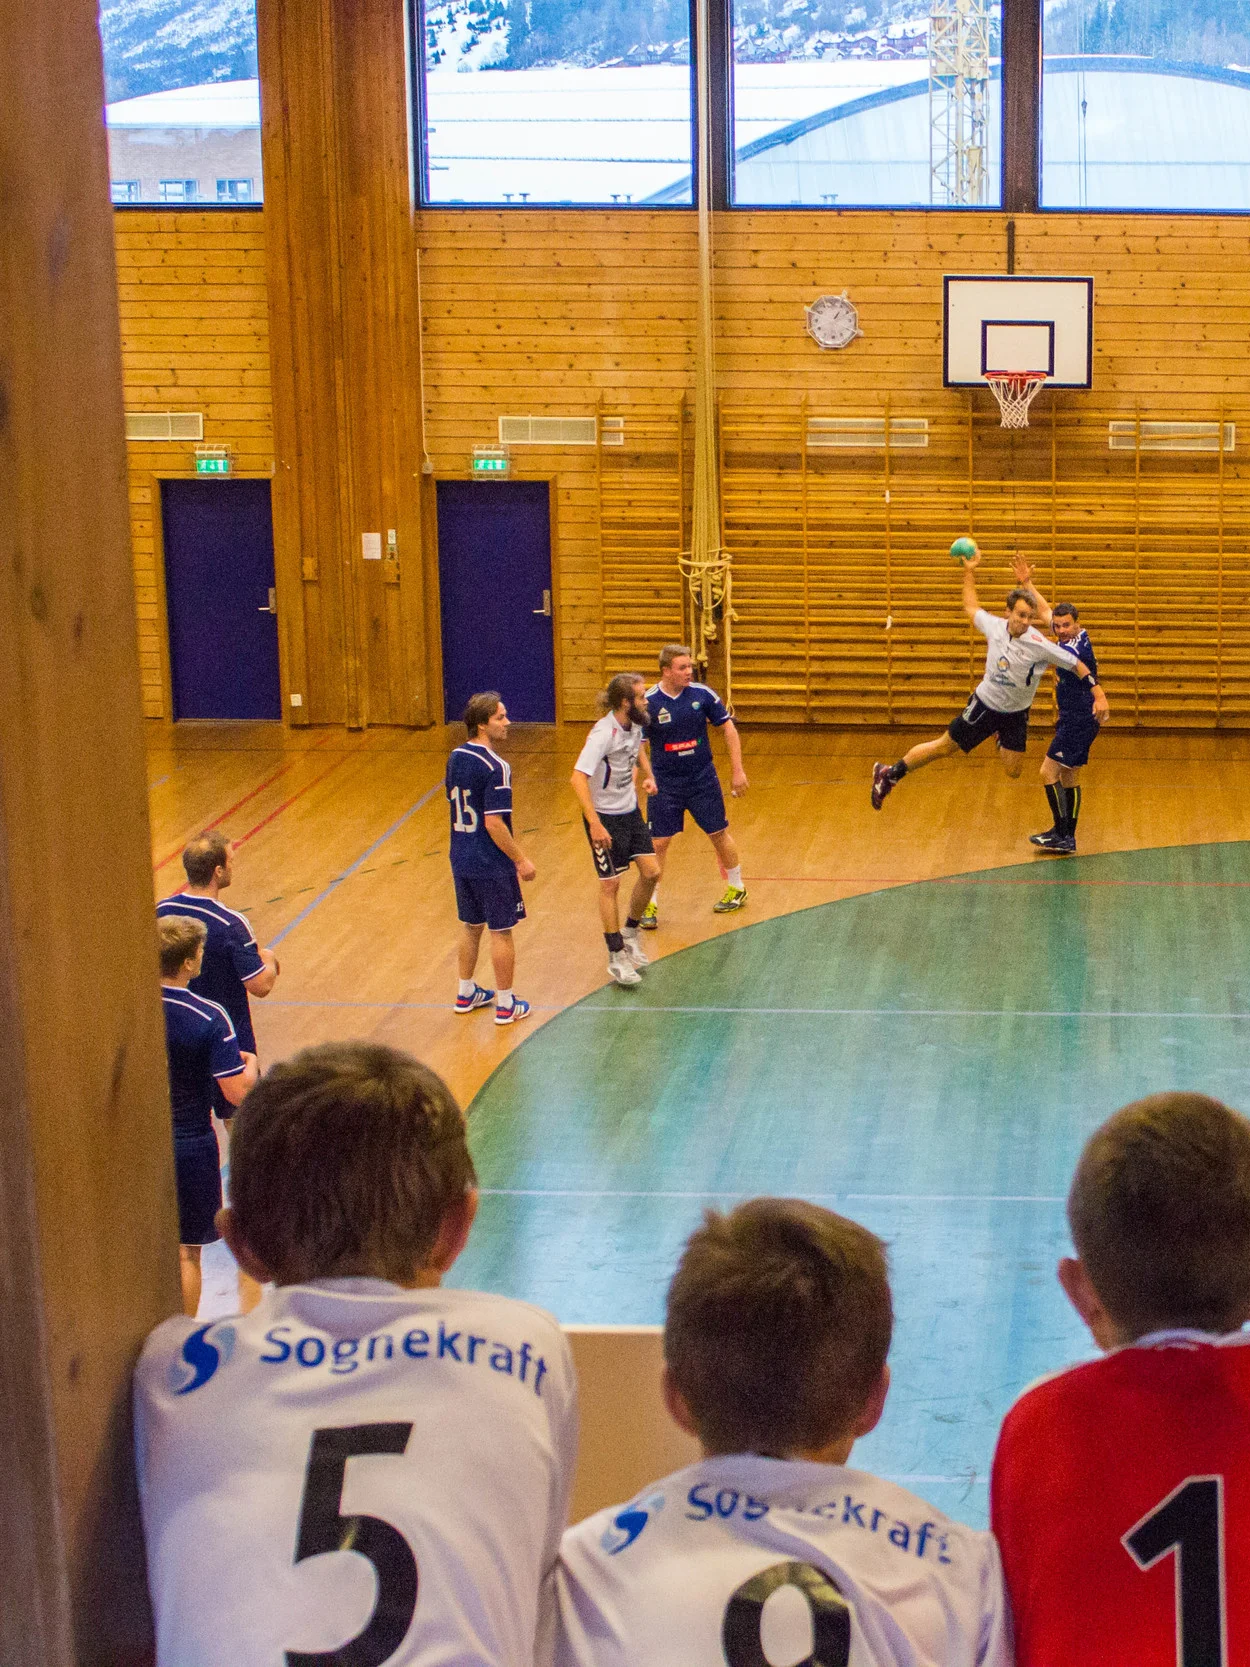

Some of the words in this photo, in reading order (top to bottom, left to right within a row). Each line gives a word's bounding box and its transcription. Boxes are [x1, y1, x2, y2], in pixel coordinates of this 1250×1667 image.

[450, 786, 478, 833] 15
[259, 1320, 548, 1397] Sognekraft
[283, 1421, 420, 1667] 5
[685, 1482, 952, 1565] Sogkraft
[1120, 1473, 1229, 1667] 1
